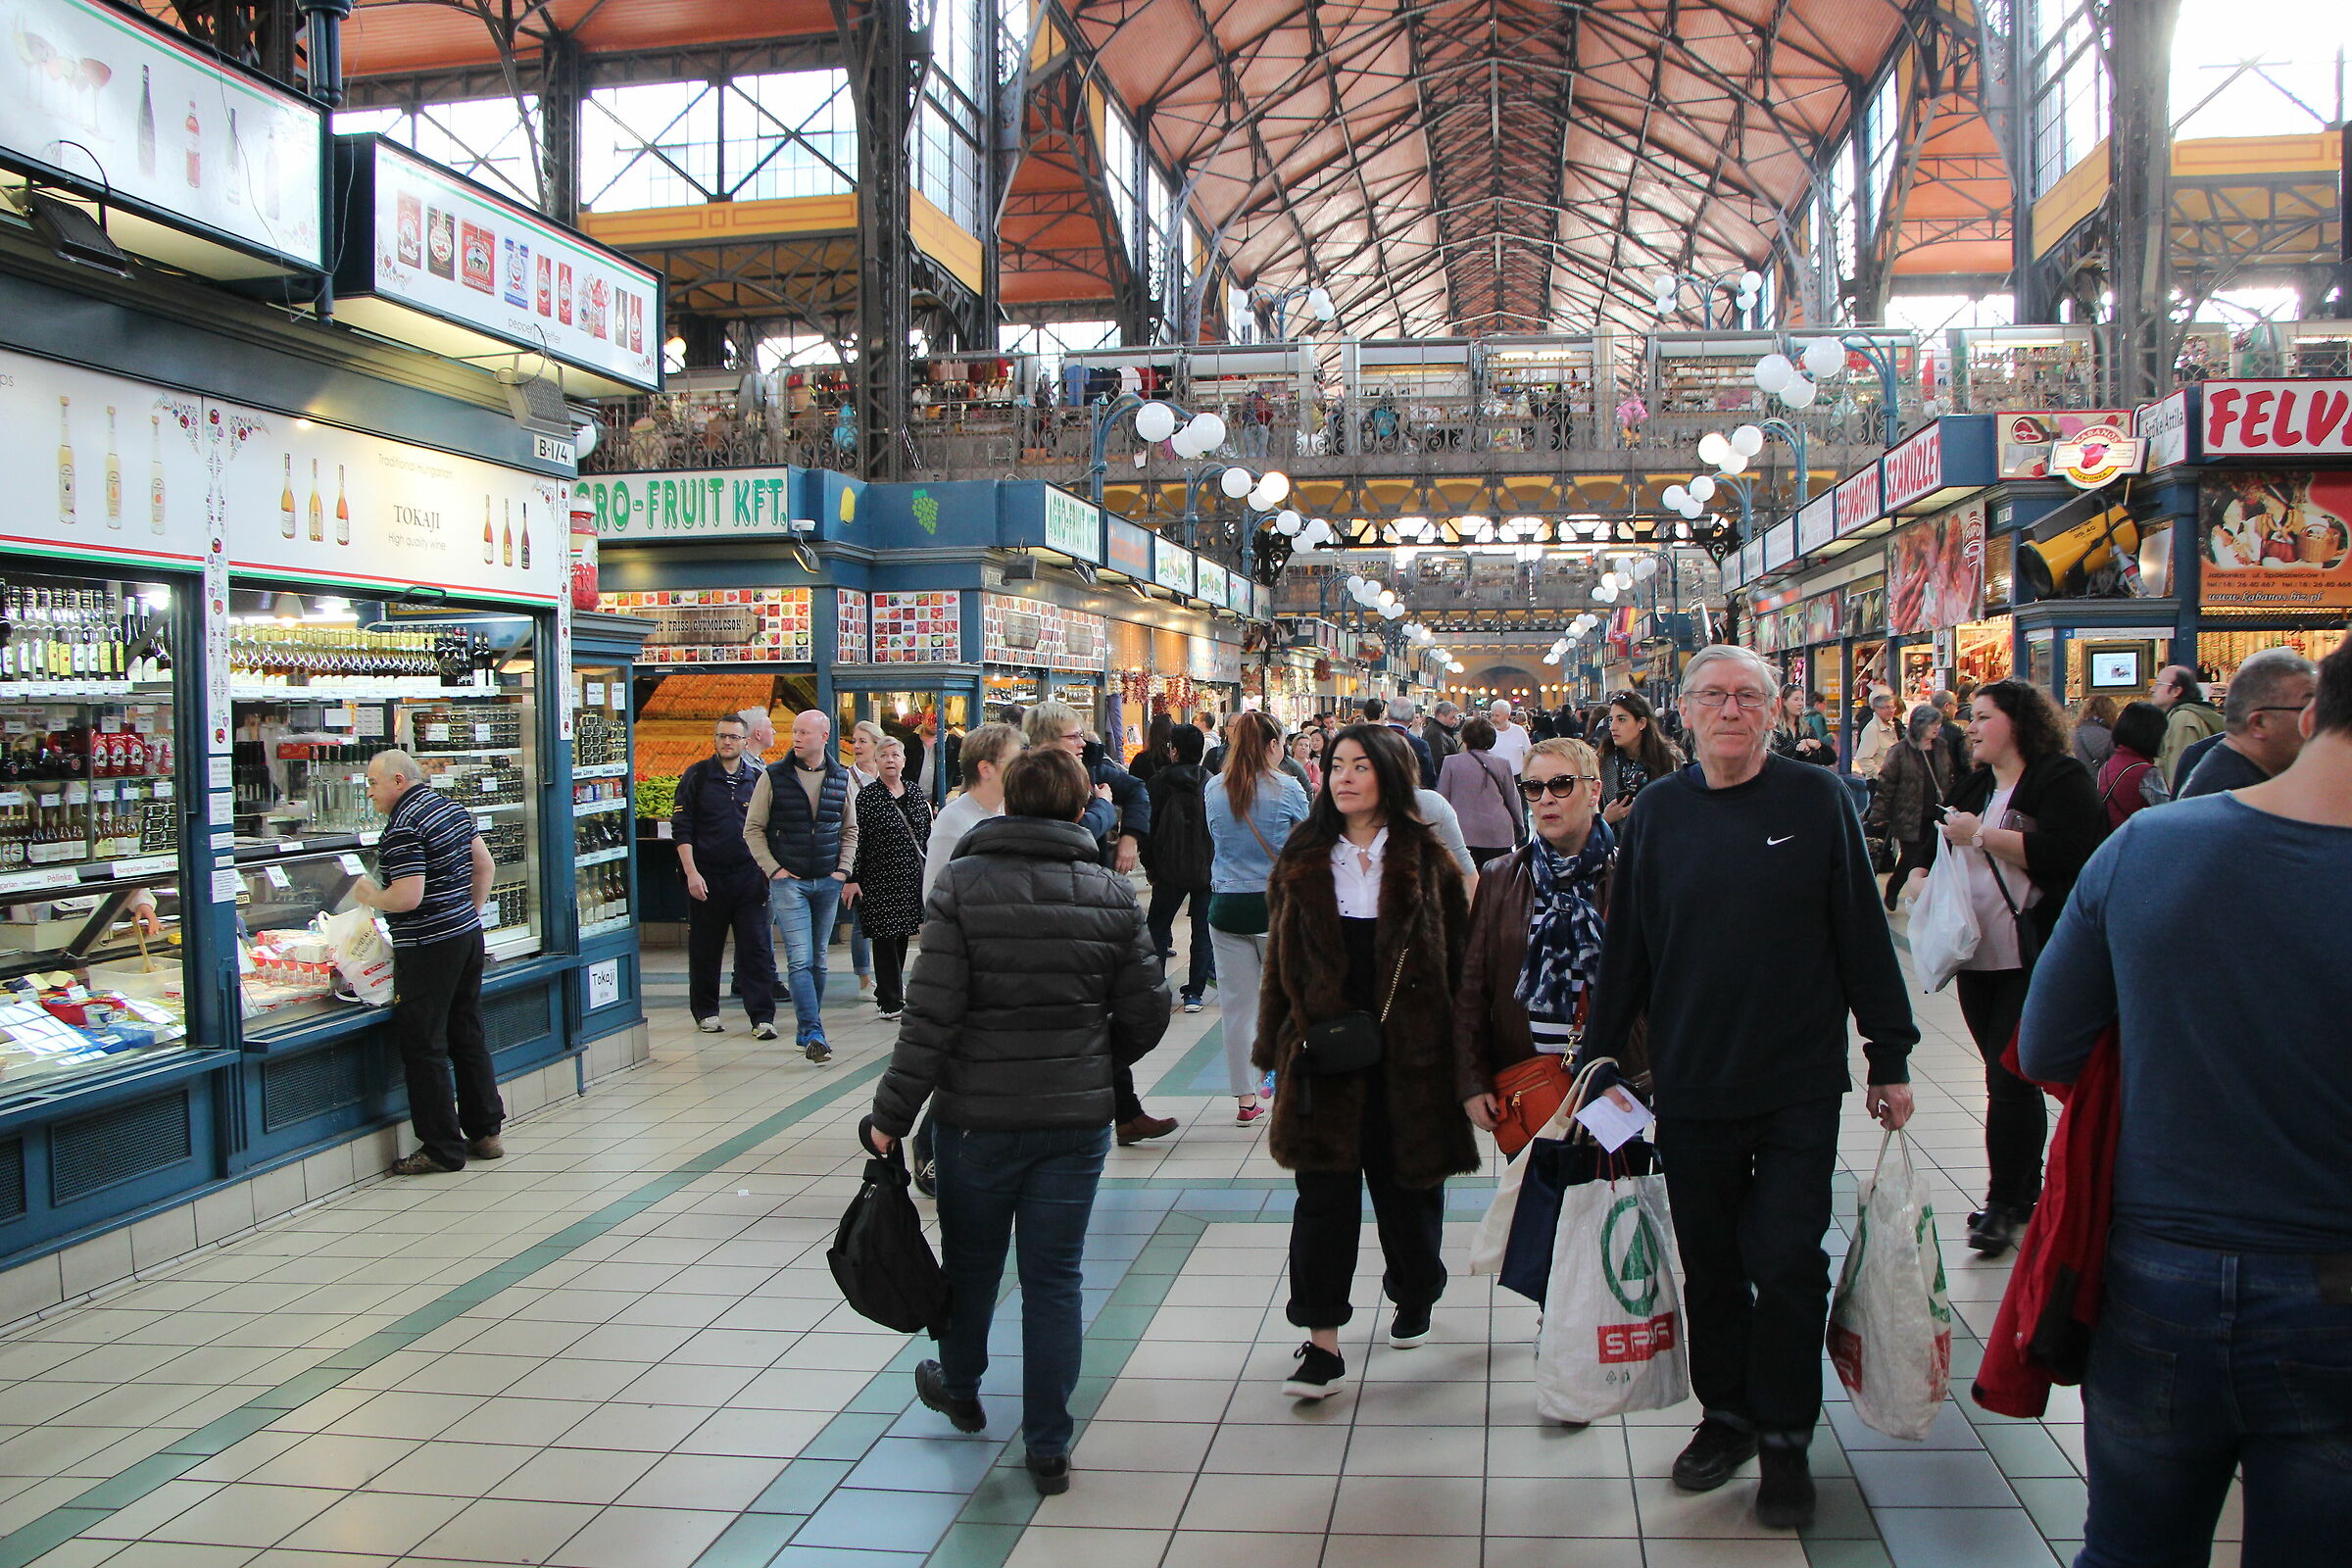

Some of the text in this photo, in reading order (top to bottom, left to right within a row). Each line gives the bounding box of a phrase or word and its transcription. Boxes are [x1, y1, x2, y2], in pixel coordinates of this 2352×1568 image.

[732, 477, 787, 527] KFT.
[393, 505, 441, 532] TOKAJI
[388, 532, 406, 546] High
[429, 538, 446, 551] wine
[668, 619, 689, 632] FRISS
[592, 968, 615, 986] Tokaji
